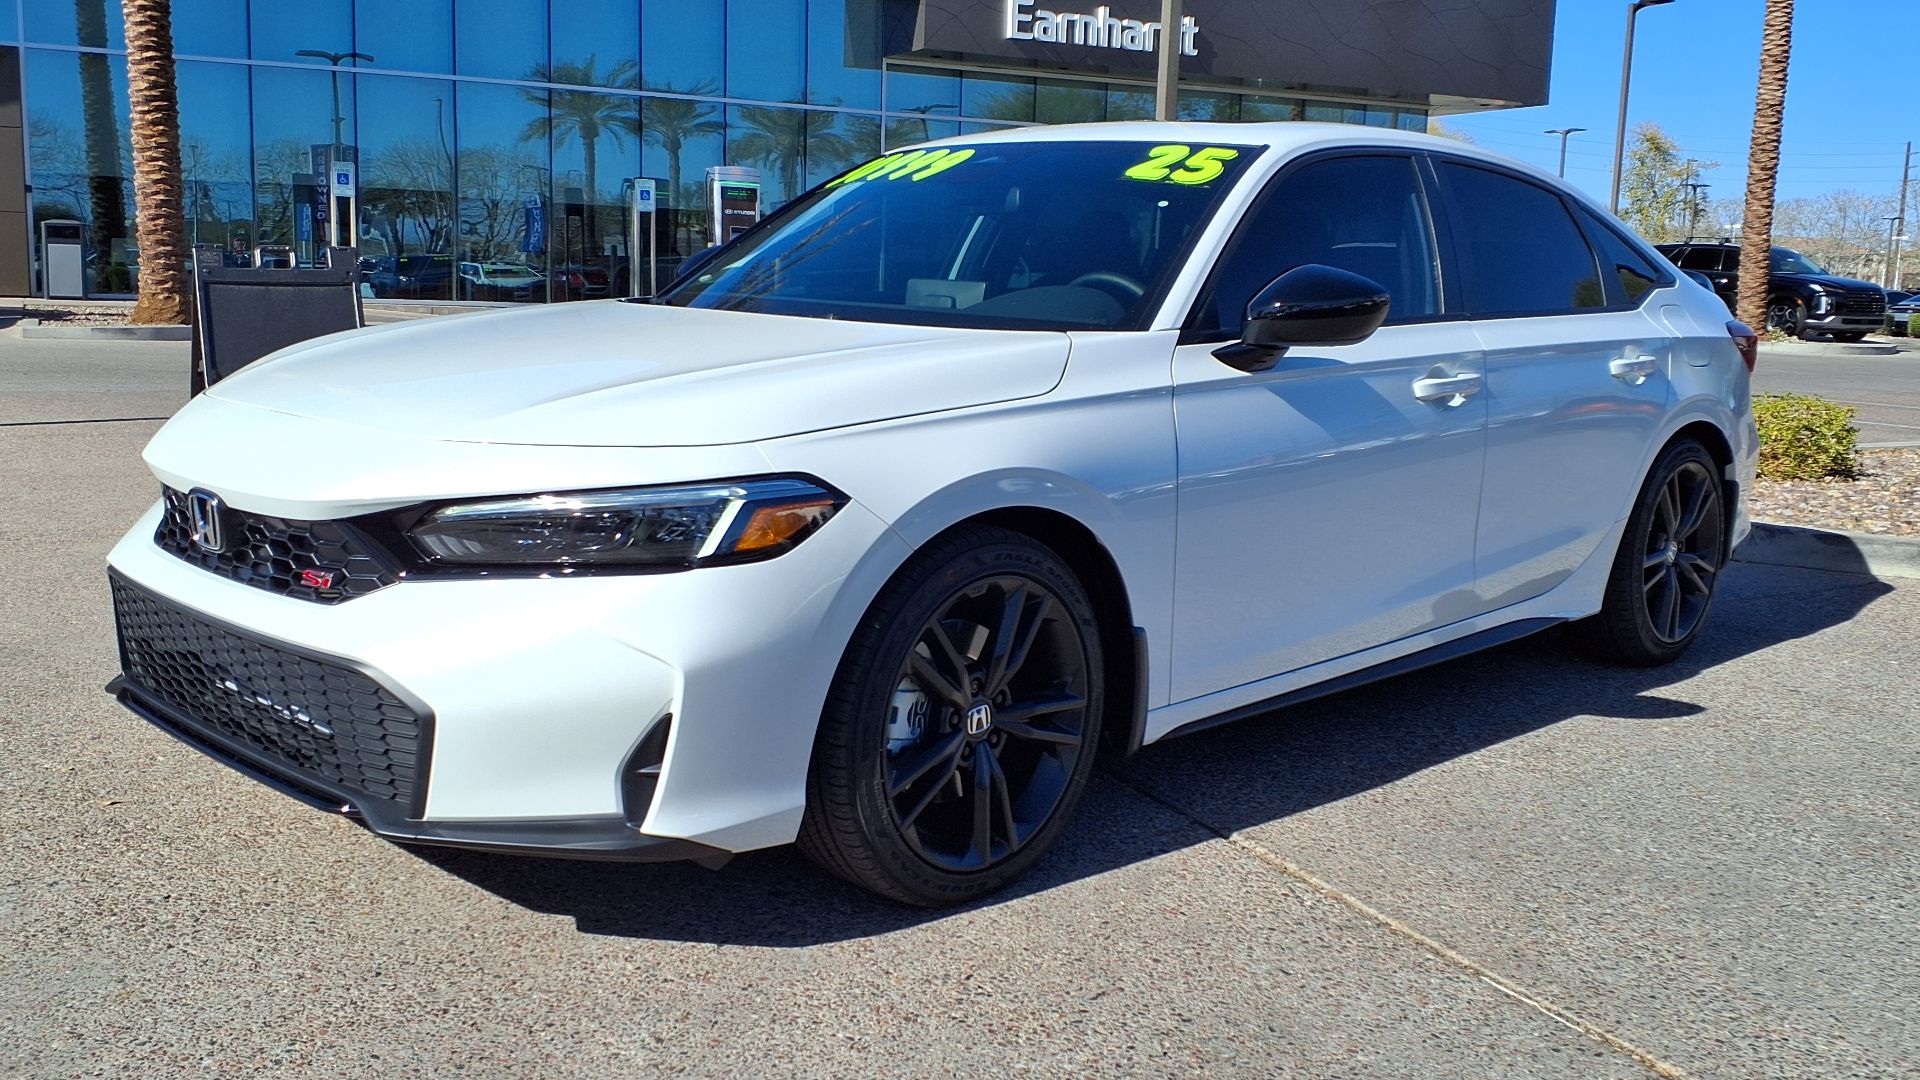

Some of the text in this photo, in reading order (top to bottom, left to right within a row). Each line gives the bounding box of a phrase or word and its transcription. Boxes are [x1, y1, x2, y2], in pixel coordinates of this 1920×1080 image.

[1007, 0, 1200, 56] Earnhart
[1125, 144, 1239, 185] 25
[301, 570, 335, 589] Si
